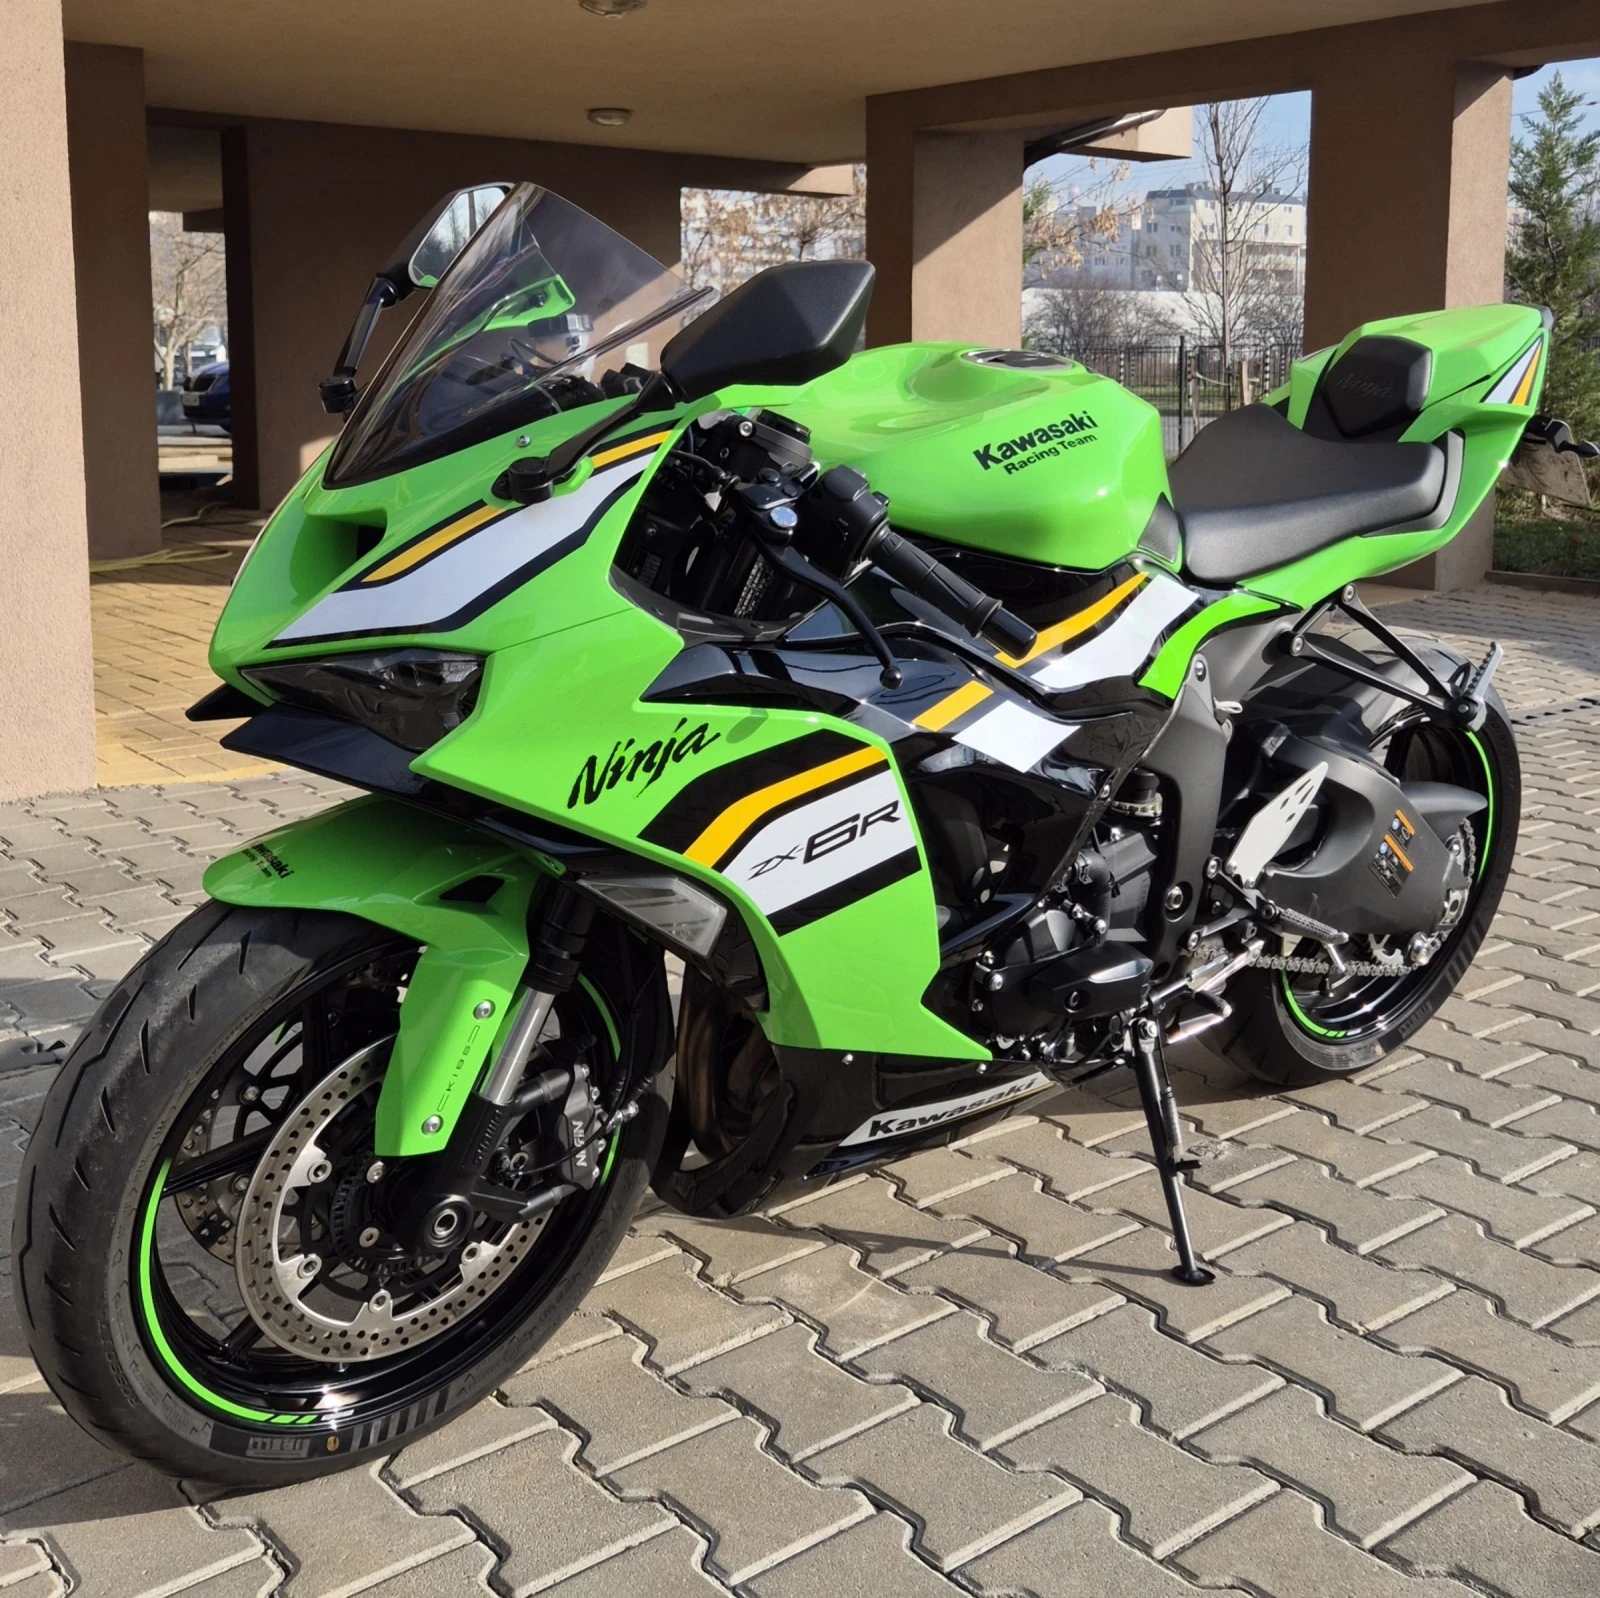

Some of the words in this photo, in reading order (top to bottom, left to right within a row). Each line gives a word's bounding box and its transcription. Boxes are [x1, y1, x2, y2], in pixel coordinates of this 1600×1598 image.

[973, 410, 1099, 471] Kawasaki
[1003, 446, 1061, 475] Racing
[1056, 434, 1098, 451] Team
[567, 717, 722, 809] Ninja
[746, 799, 902, 881] ZX-6R
[868, 1078, 1038, 1138] Kawasaki
[246, 1436, 311, 1458] PIRELLI
